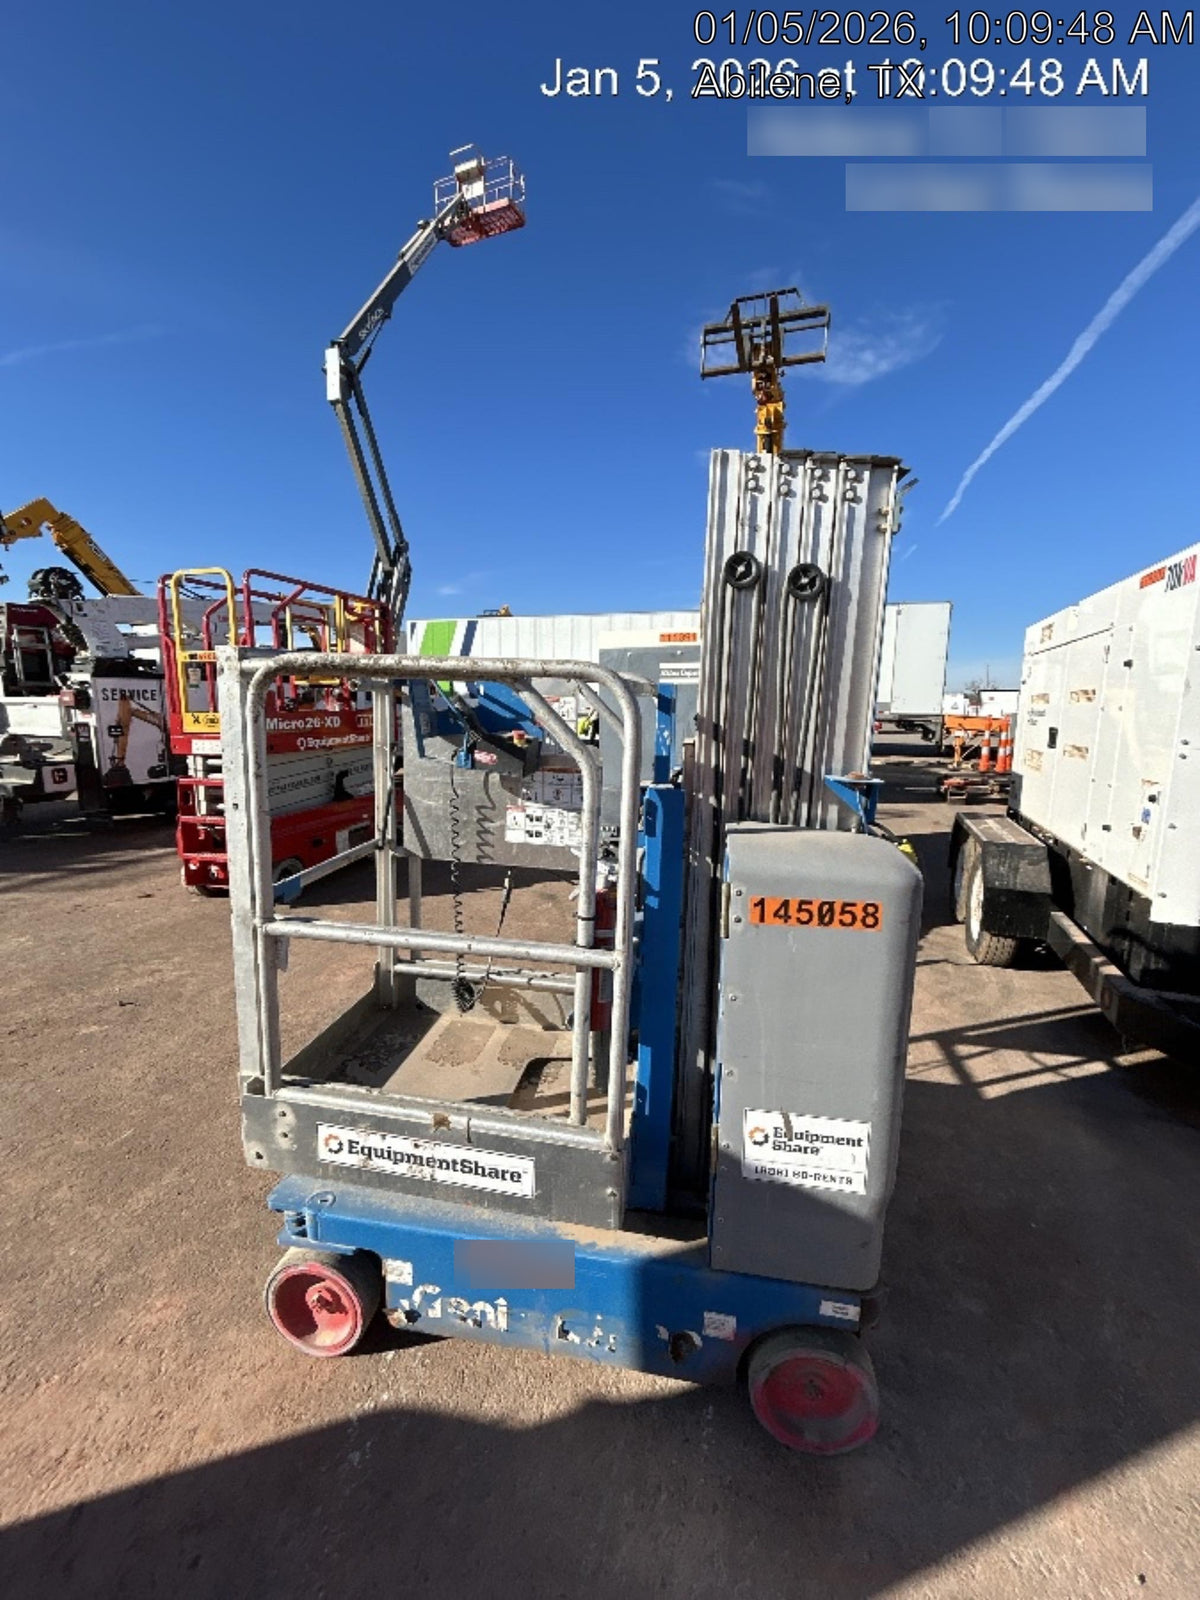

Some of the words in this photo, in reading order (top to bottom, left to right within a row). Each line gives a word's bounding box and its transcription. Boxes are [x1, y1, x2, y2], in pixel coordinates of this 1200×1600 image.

[102, 687, 157, 701] SERVICE
[753, 897, 879, 929] 145058
[772, 1140, 821, 1156] Share
[773, 1126, 864, 1148] Euipment
[347, 1138, 523, 1184] EquipmentShare
